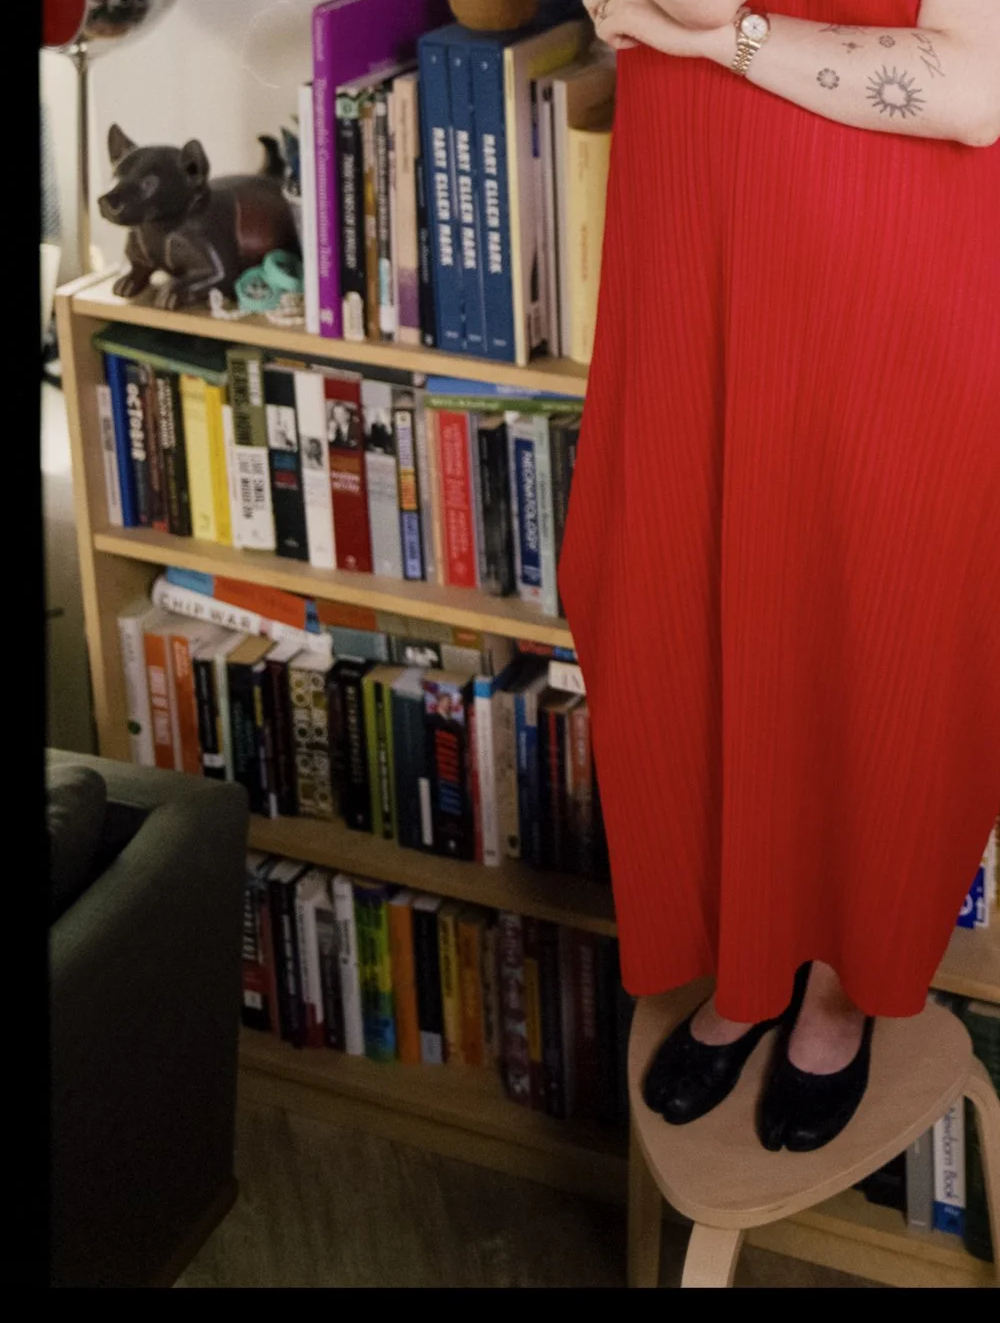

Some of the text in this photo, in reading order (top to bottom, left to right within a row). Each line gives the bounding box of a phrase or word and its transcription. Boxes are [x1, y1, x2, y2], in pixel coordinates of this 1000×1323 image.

[431, 127, 453, 267] MARY ELLEN MARK
[456, 130, 477, 270] MARY ELLEN MARK
[482, 133, 503, 274] MARY ELLEN MARK
[522, 450, 539, 551] NEONATOLOGY
[159, 589, 252, 632] CHIP WAR
[943, 1169, 958, 1198] Book
